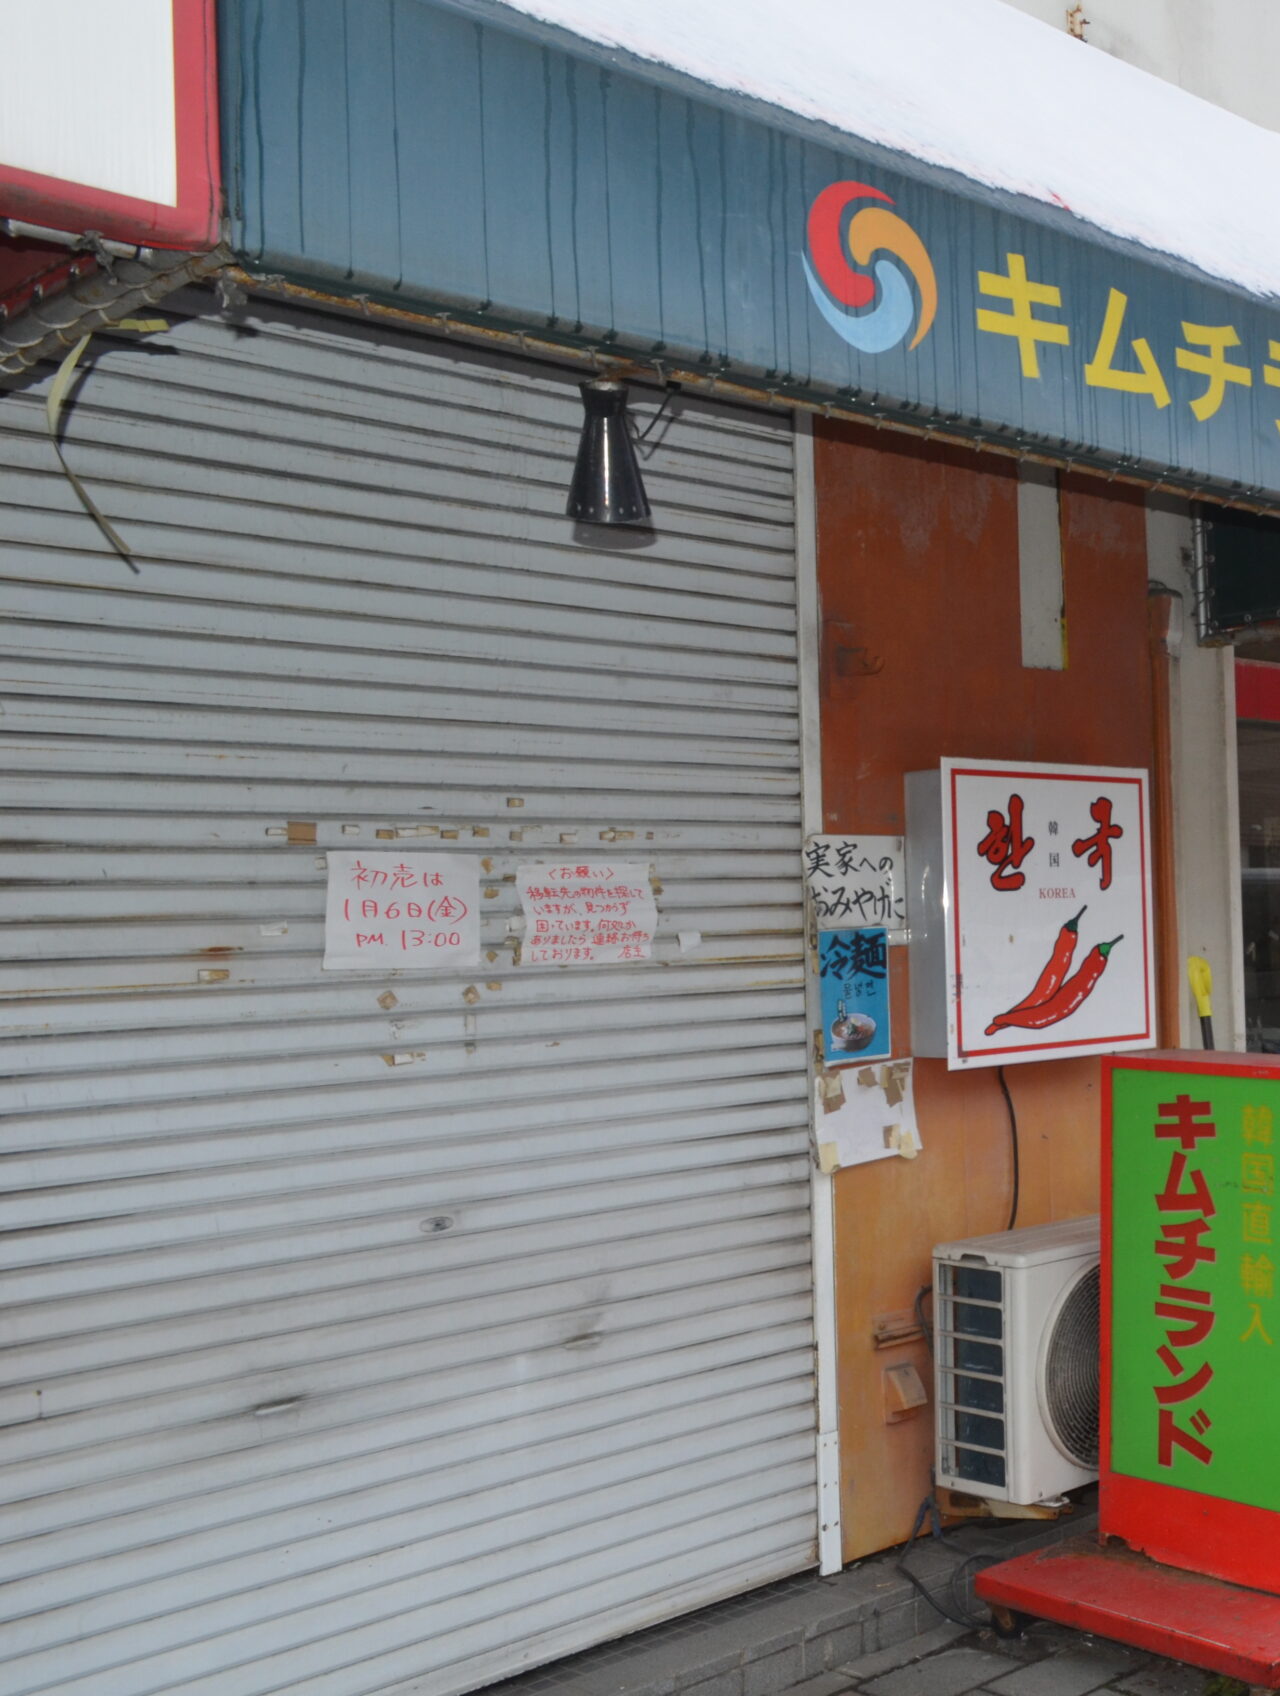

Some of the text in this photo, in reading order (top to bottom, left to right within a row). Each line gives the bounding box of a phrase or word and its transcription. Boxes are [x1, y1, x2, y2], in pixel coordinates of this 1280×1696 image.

[805, 841, 894, 879] 実家への
[977, 793, 1124, 892] 한국
[1047, 819, 1061, 868] 韓国
[352, 860, 445, 891] 初売は
[1038, 886, 1077, 900] KOREA
[402, 930, 461, 950] 13:00
[1239, 1104, 1275, 1346] 韓国直輸入
[1153, 1094, 1217, 1469] キムチランド
